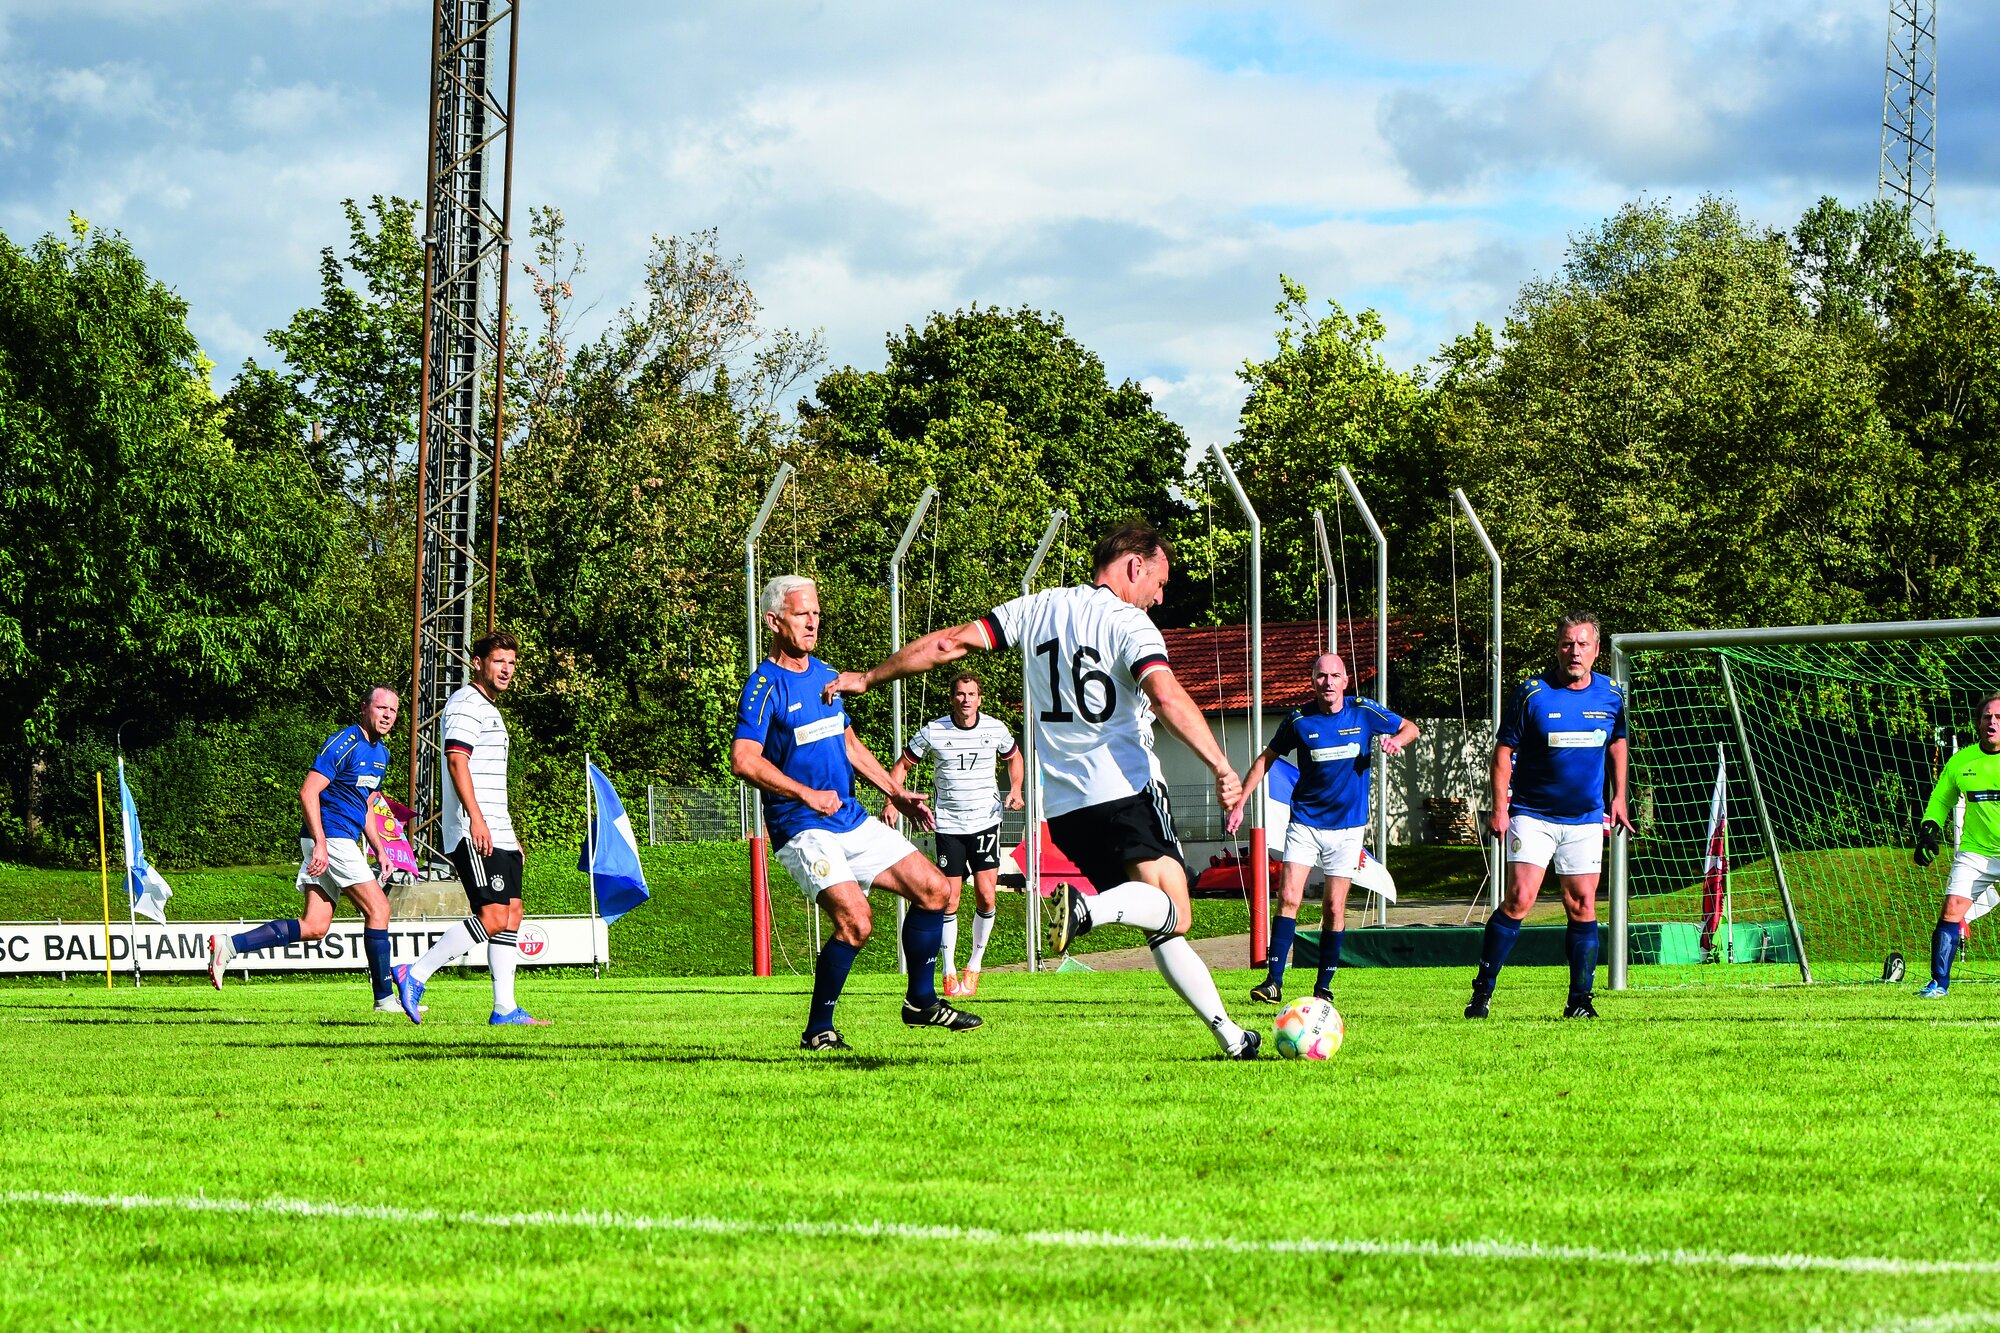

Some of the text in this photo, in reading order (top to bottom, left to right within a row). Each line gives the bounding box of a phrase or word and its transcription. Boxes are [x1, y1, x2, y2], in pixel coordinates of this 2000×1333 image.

[1036, 637, 1116, 723] 16
[956, 752, 979, 771] 17
[976, 833, 997, 854] 17
[0, 934, 30, 961] C
[44, 933, 205, 961] BALDHAM
[524, 932, 538, 942] SC
[523, 943, 540, 953] BV
